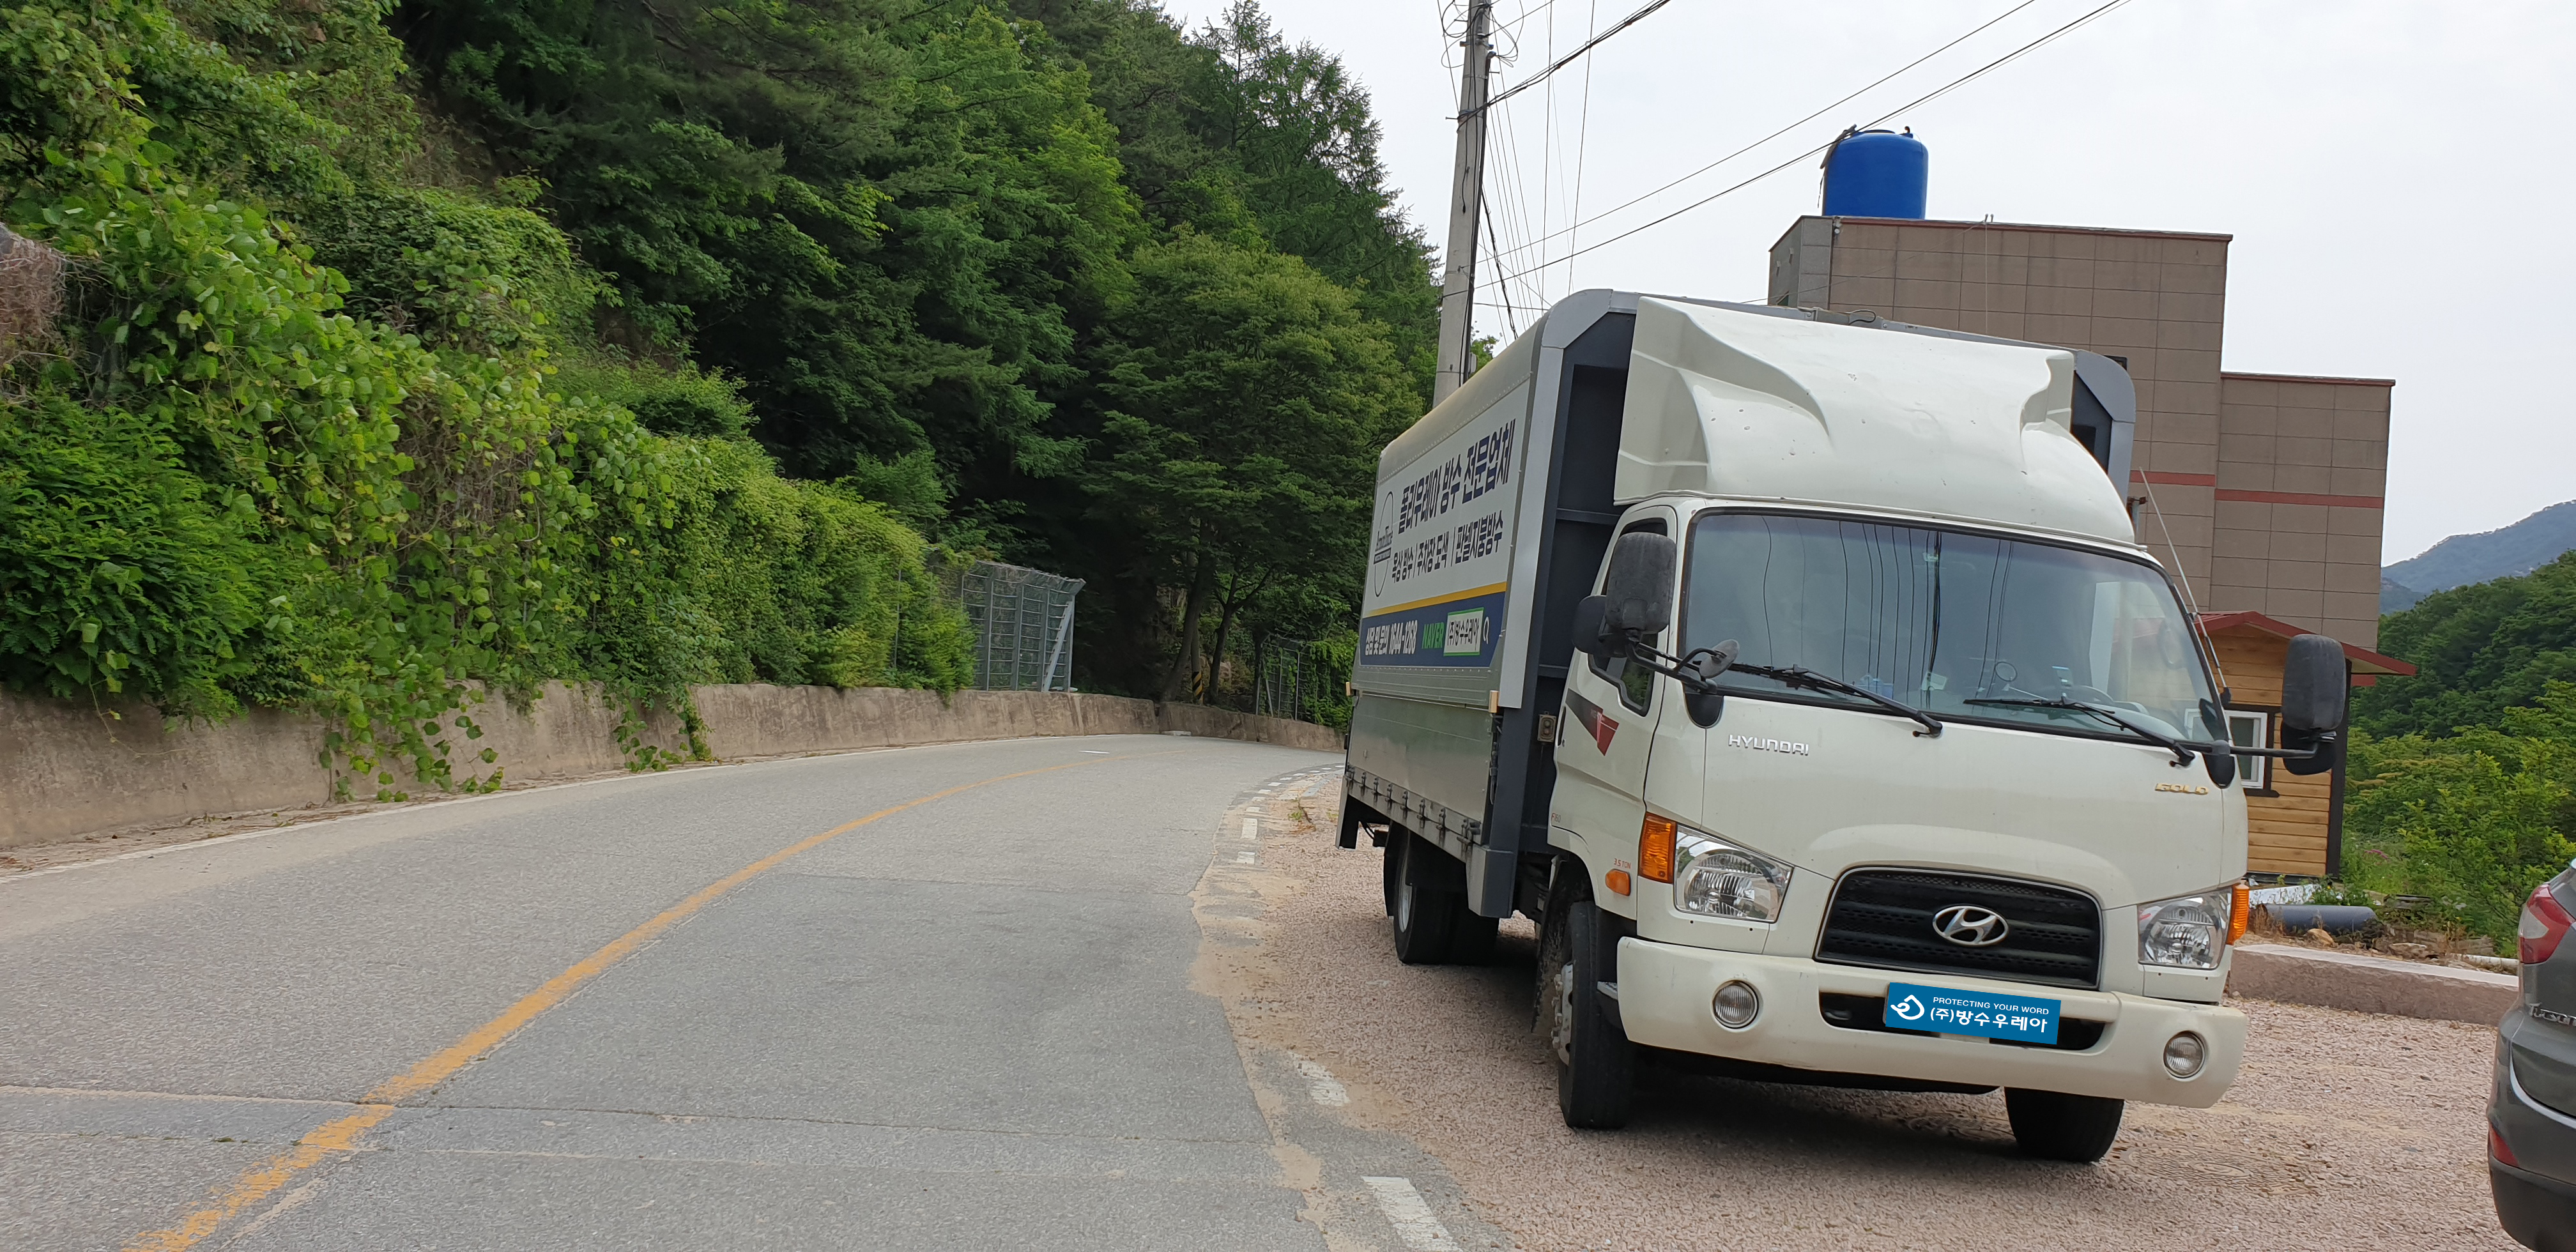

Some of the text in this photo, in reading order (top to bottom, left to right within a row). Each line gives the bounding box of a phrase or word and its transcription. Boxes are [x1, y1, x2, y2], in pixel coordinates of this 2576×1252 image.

[1399, 418, 1516, 535] 폴리우레아 방수 전문업체
[1392, 549, 1403, 583] 옥상
[1402, 547, 1413, 580] 방수
[1417, 537, 1436, 576] 주차장
[1434, 531, 1450, 570] 도색
[1455, 510, 1503, 565] 판넬지붕방수
[1365, 620, 1418, 655] 상담 및 문의 1644-1268
[1422, 622, 1445, 649] NAVER
[1446, 617, 1480, 652] (주)방수우레아
[1728, 734, 1809, 756] HYUNDAI
